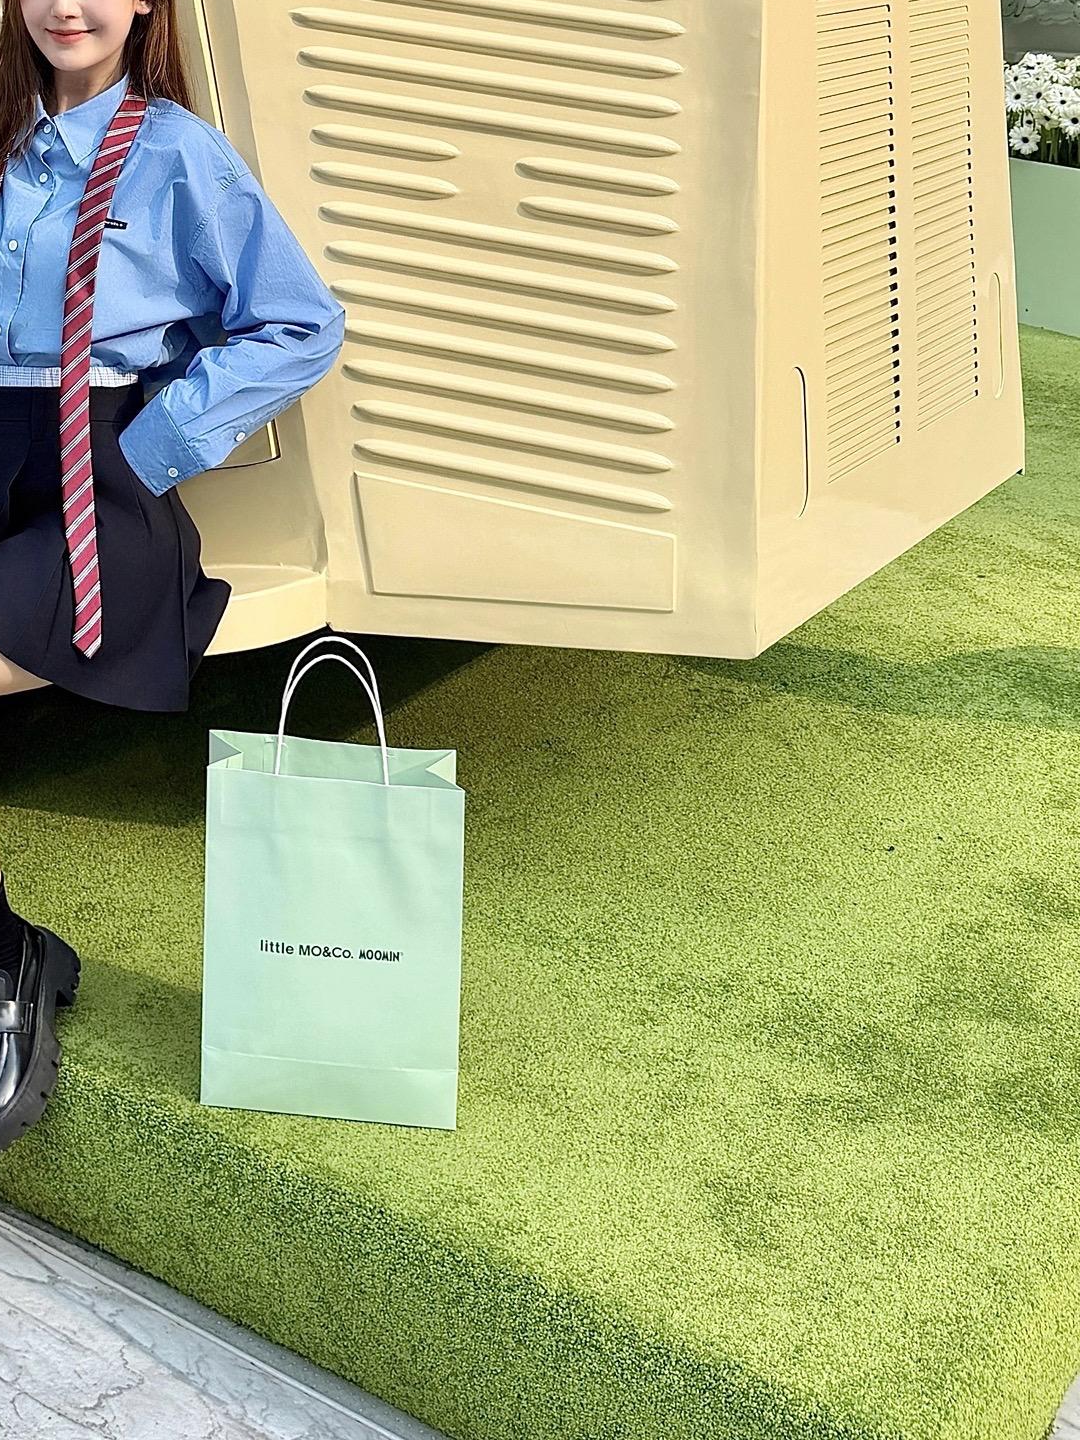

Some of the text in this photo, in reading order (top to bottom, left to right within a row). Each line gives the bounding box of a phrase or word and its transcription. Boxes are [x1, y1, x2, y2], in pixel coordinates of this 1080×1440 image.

[260, 939, 400, 962] little MO&Co. MOOMIN
